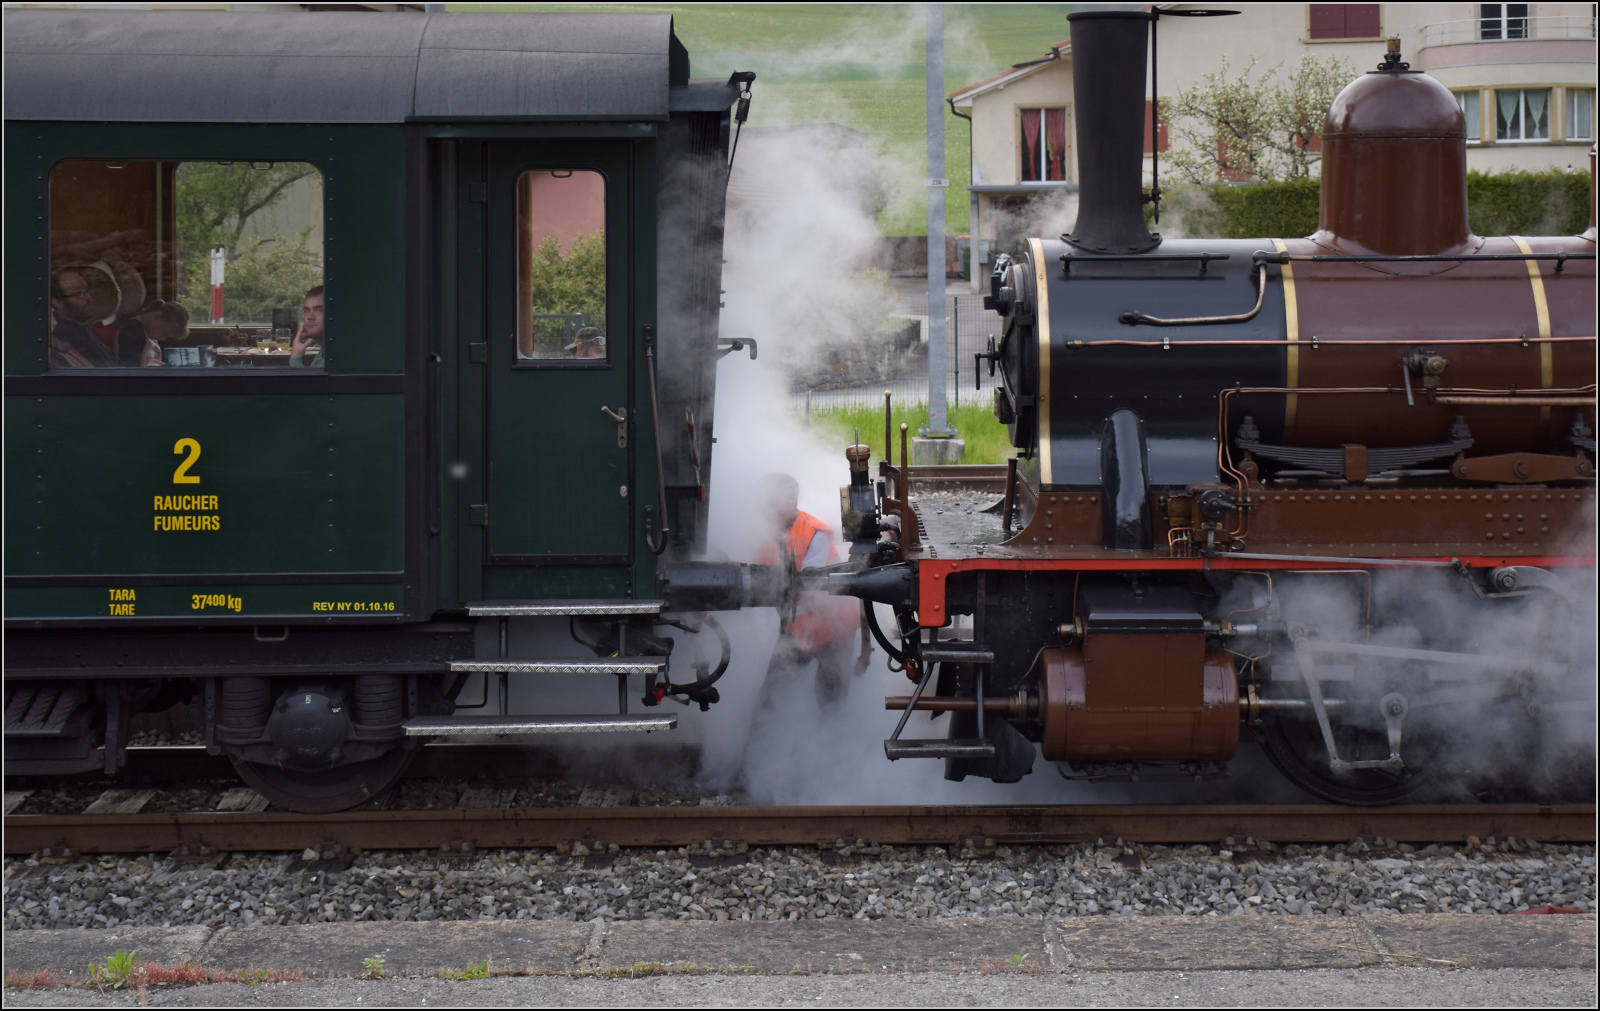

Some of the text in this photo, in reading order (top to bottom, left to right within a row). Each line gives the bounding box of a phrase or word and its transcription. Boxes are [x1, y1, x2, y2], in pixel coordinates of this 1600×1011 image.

[173, 437, 201, 484] 2
[154, 495, 219, 511] RAUCHER
[154, 515, 221, 531] FUMEURS
[109, 589, 136, 601] TARA
[191, 594, 242, 612] 37400 kg
[109, 604, 135, 616] TARE
[312, 602, 395, 611] REV NY 01.10.16
